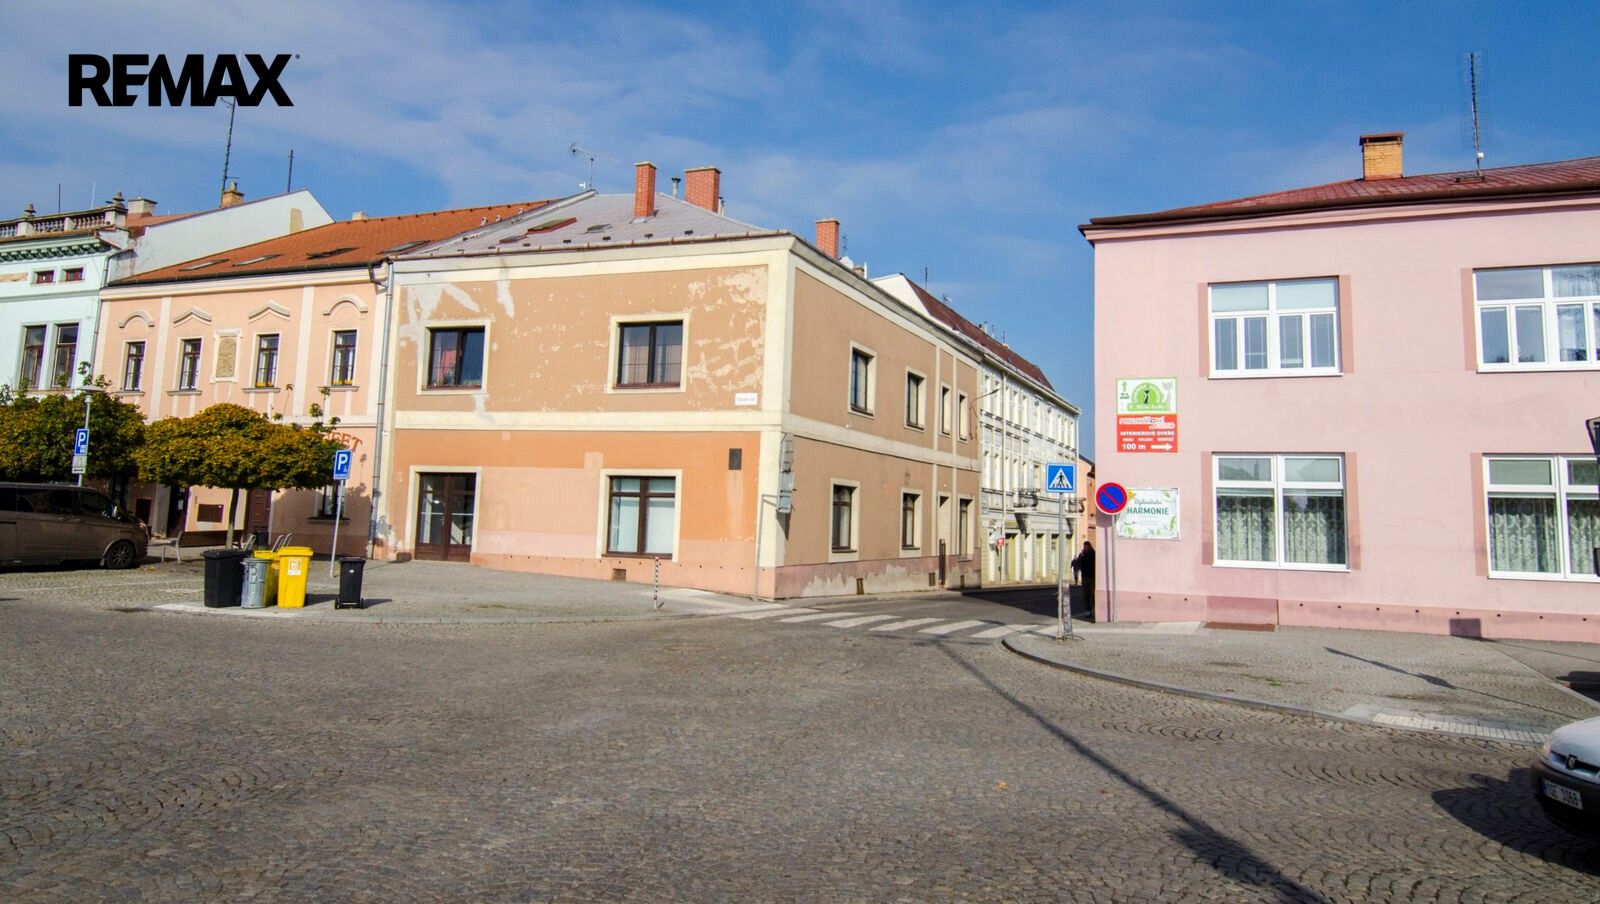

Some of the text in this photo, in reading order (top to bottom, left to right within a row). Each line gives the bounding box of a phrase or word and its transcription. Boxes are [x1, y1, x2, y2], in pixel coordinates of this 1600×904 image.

[78, 432, 86, 447] P
[338, 454, 348, 470] P
[1127, 507, 1169, 515] HARMONIE
